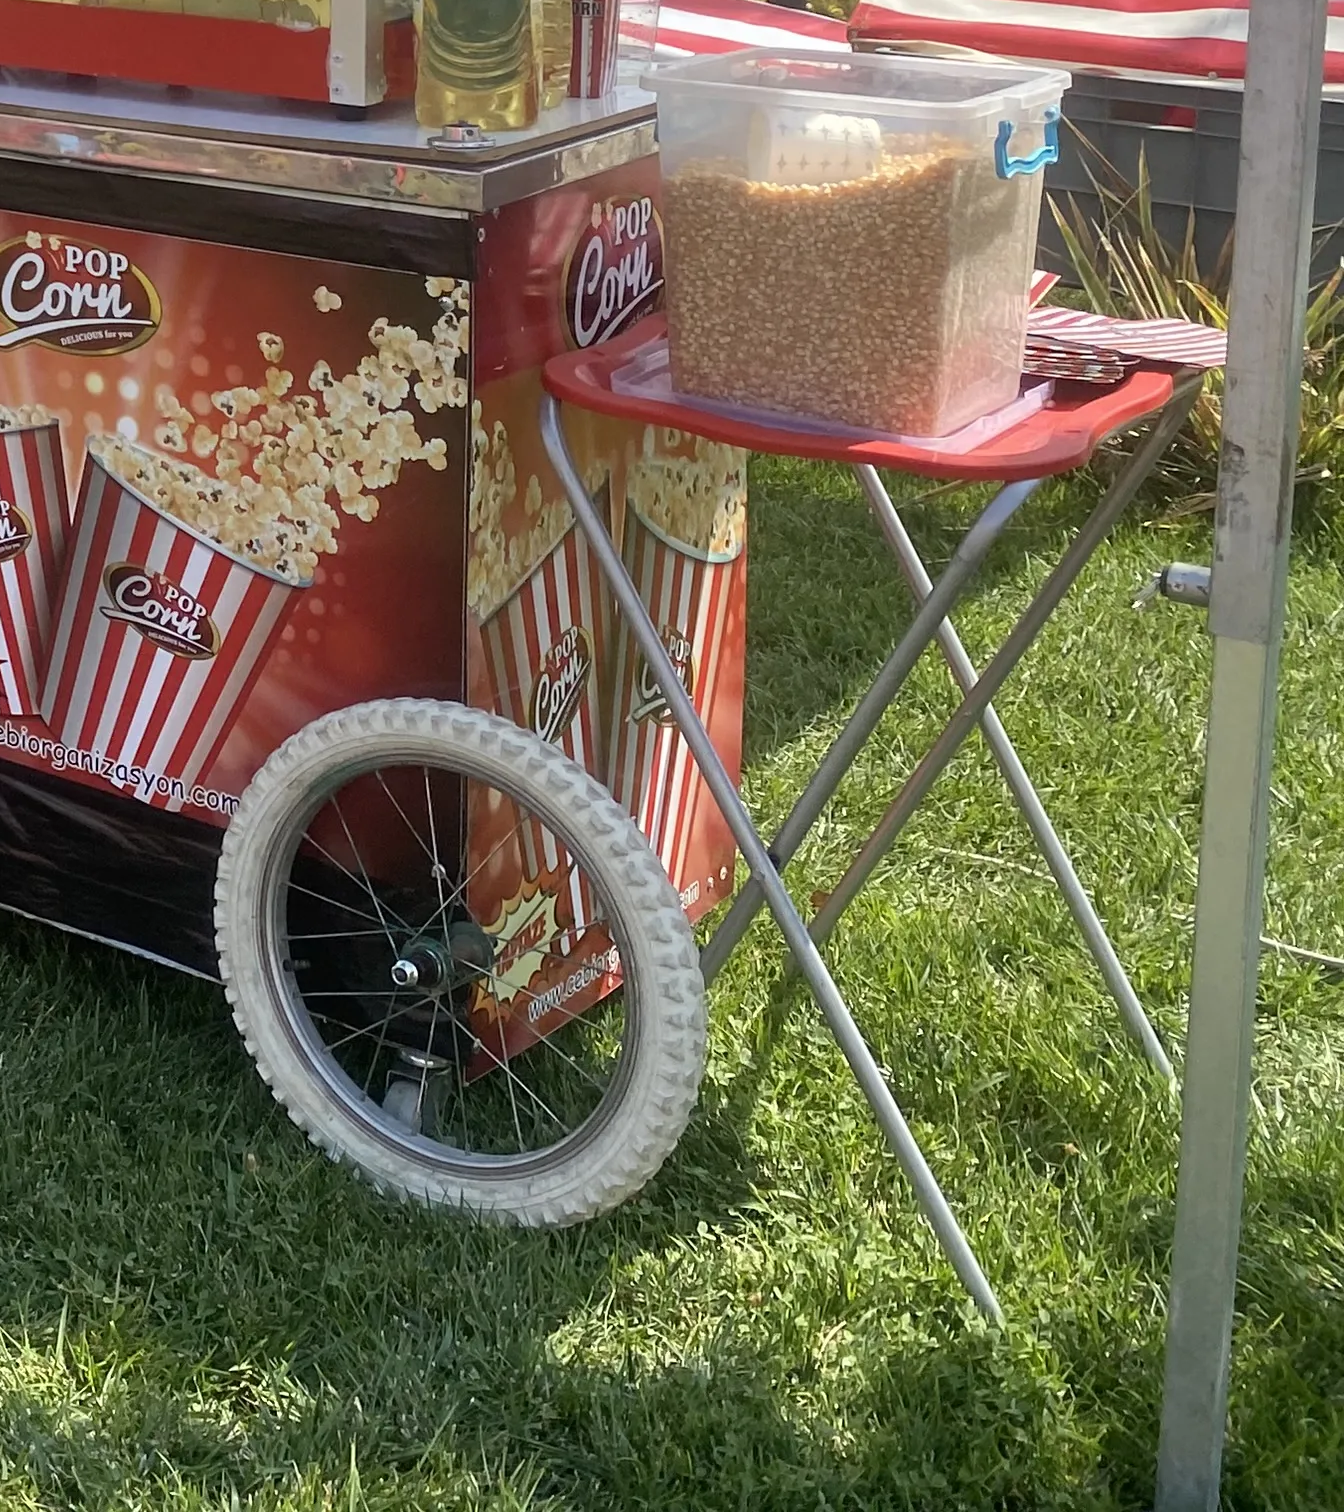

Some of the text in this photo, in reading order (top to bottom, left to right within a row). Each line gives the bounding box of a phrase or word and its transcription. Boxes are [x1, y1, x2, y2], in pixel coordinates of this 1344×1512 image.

[615, 197, 652, 245] POP
[64, 244, 129, 281] POP
[1, 252, 133, 323] Corn
[574, 235, 654, 348] Corn
[60, 330, 104, 346] DELICIOUS
[115, 575, 201, 640] Corn
[164, 584, 207, 620] POP
